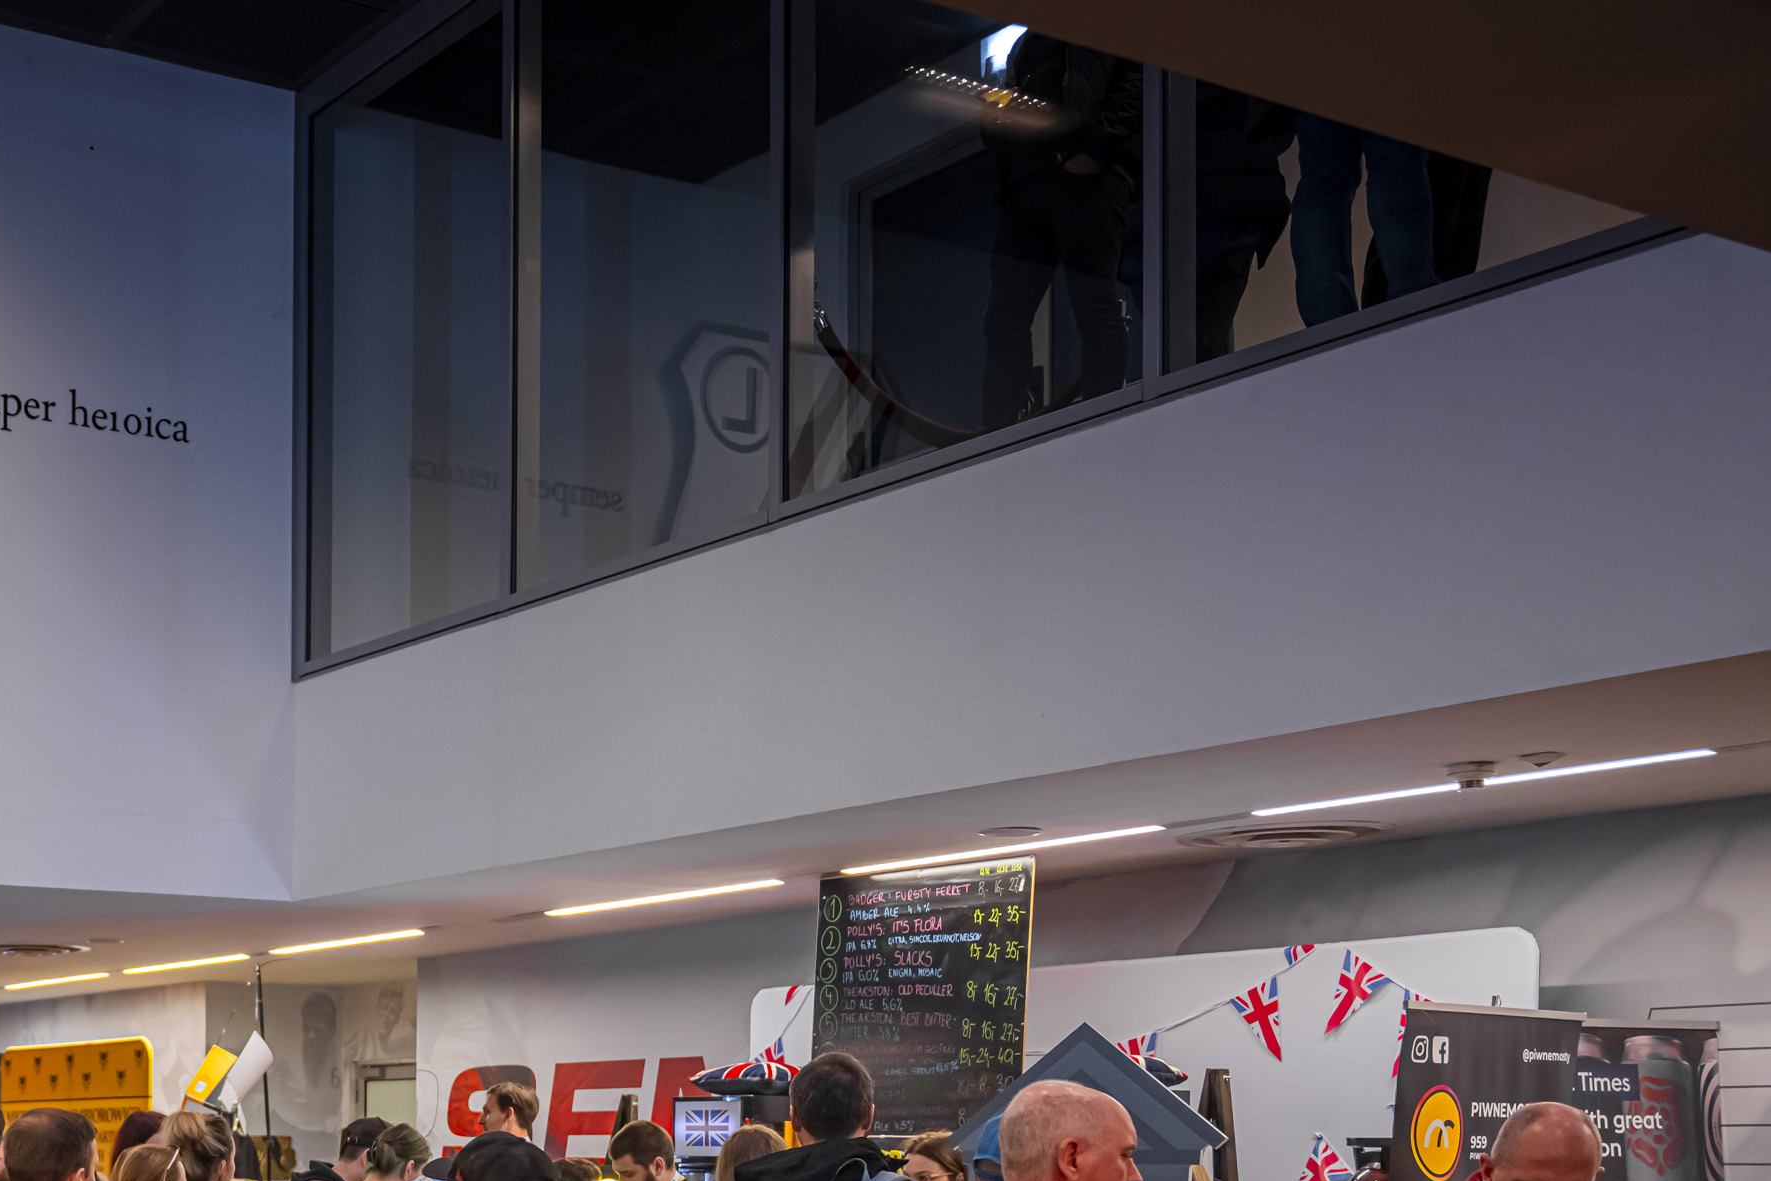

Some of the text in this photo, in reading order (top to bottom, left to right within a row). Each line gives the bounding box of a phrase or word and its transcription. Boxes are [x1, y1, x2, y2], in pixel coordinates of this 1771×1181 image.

[936, 884, 971, 897] FERRET
[850, 908, 881, 921] AMBER
[884, 907, 899, 917] ALE
[914, 916, 943, 932] FLORA
[845, 942, 856, 953] IPA
[894, 950, 933, 967] SLACKS
[843, 970, 853, 981] IPA
[898, 984, 913, 996] OLD
[859, 999, 874, 1010] ALE
[900, 1011, 922, 1026] BEST
[925, 1012, 953, 1029] BITTER
[1523, 1048, 1571, 1064] @piwnemosty
[1577, 1071, 1631, 1092] Times
[1471, 1102, 1529, 1118] PIWNEM
[1613, 1112, 1663, 1134] great
[1470, 1135, 1488, 1149] 959
